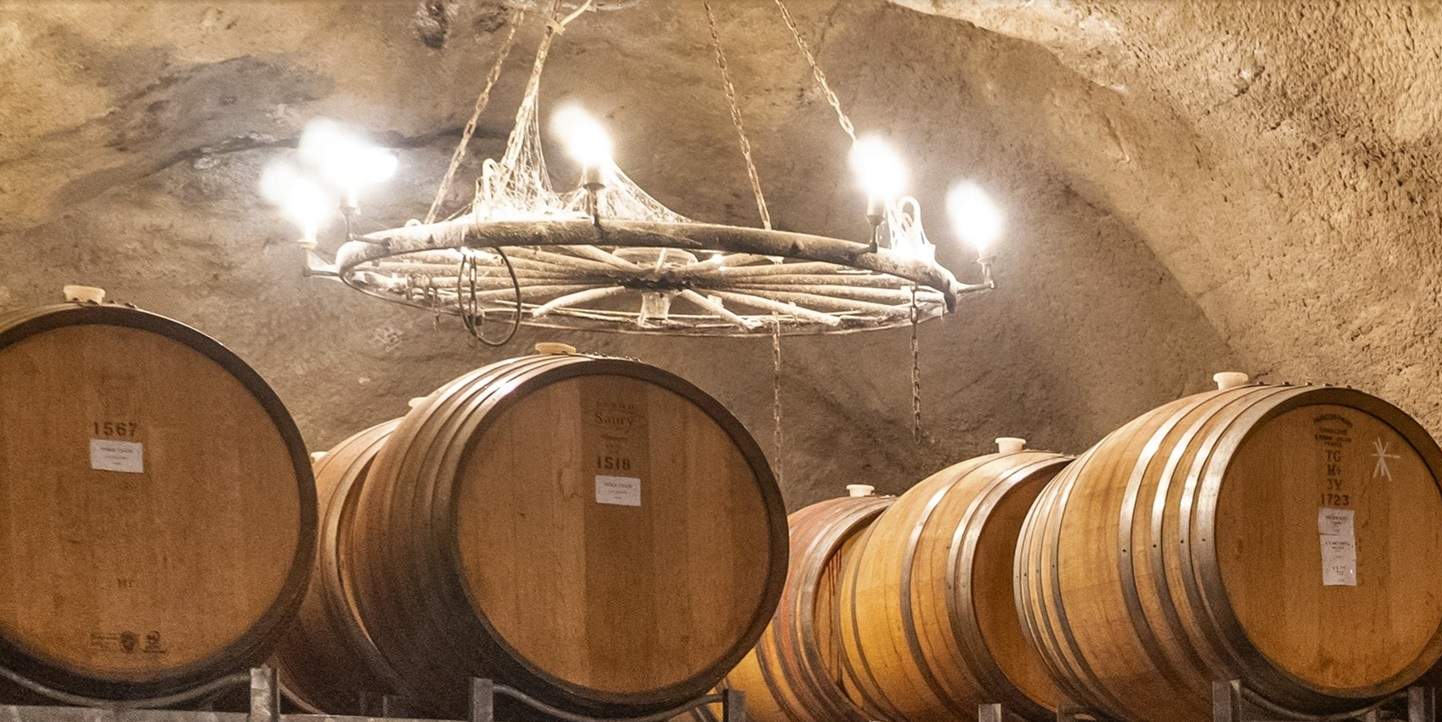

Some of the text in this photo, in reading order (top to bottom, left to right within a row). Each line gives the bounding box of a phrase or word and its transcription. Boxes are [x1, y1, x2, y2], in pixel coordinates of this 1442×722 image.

[93, 421, 139, 437] 1567
[596, 456, 632, 471] 1518
[1321, 493, 1350, 506] 1723
